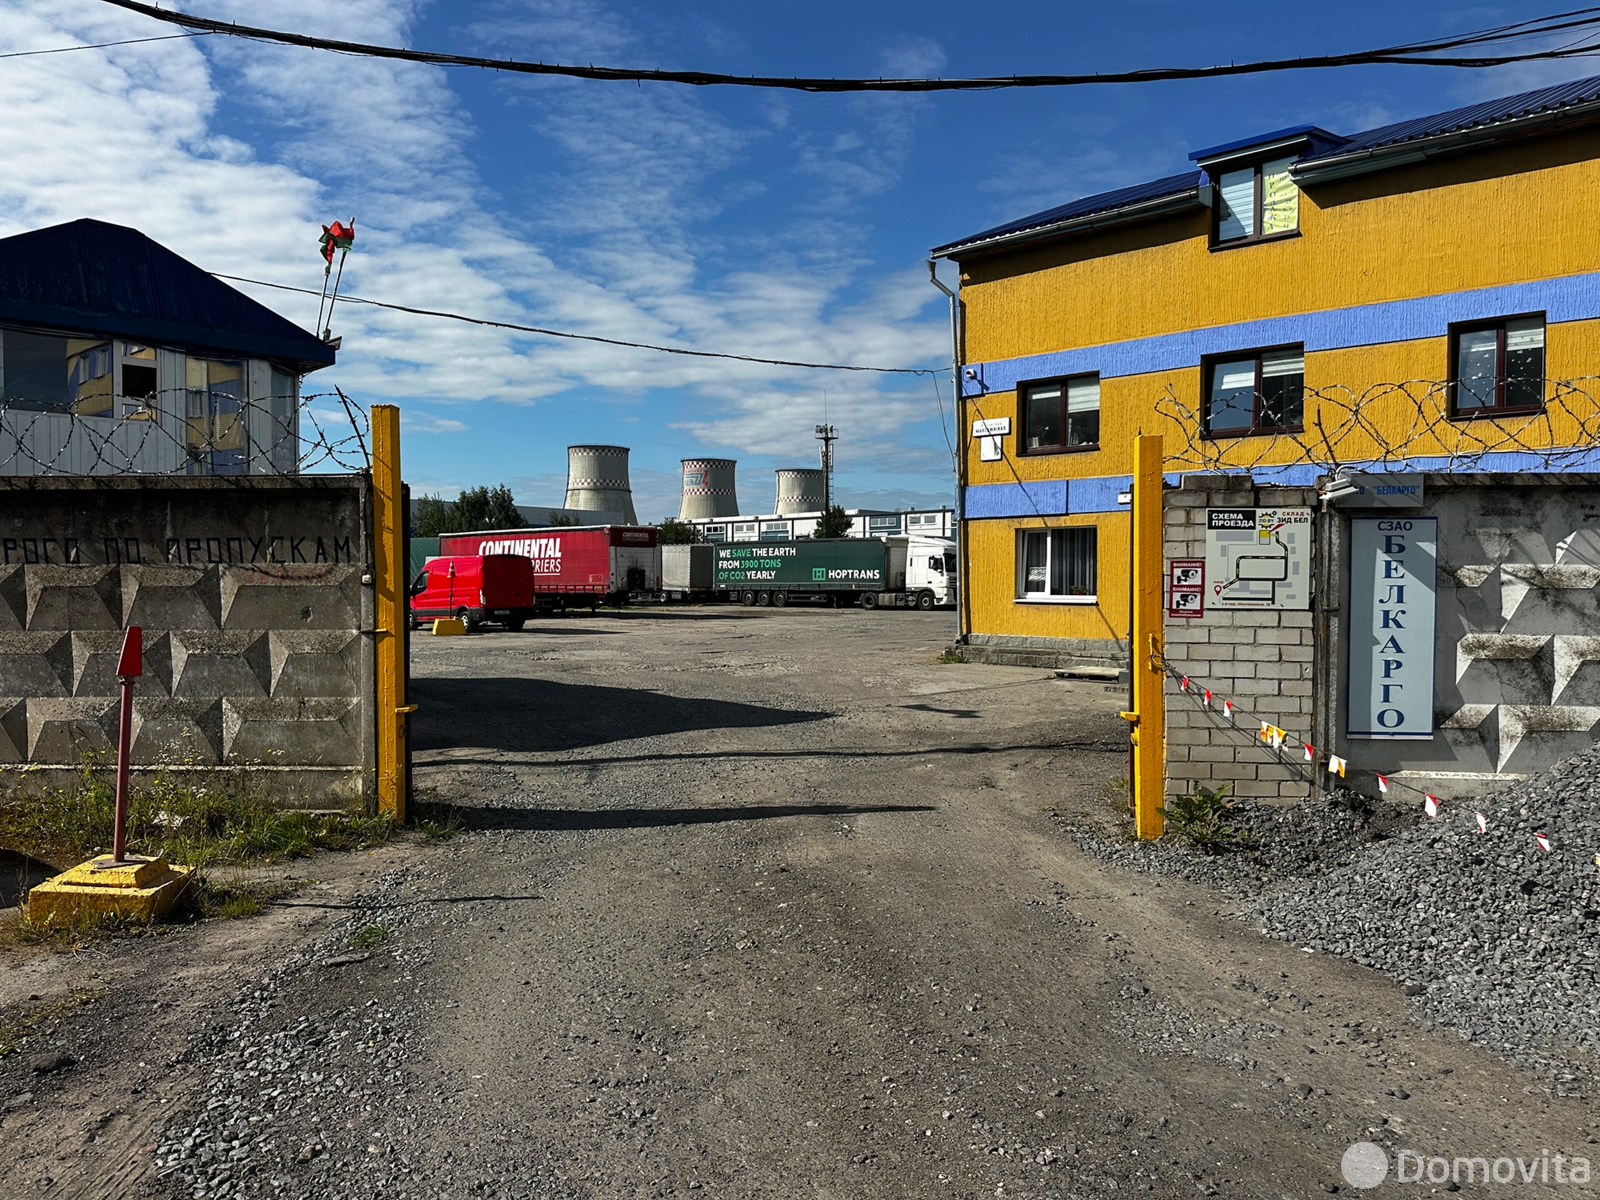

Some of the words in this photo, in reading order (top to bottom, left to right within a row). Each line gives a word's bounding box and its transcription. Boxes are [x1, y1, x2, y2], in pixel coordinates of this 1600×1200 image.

[1377, 520, 1413, 531] СЗАО
[104, 537, 142, 564] ПО
[165, 535, 351, 564] ПРОПУСКАМ
[479, 538, 561, 558] CONTINENTAL
[719, 549, 731, 558] WE
[732, 548, 751, 557] SAVE
[752, 548, 768, 557] THE
[769, 547, 796, 556] EARTH
[718, 560, 740, 569] FROM
[740, 560, 759, 568] 3900
[759, 559, 782, 568] TONS
[718, 572, 729, 580] OF
[729, 571, 745, 580] CO2
[746, 571, 776, 579] YEARLY
[828, 569, 880, 579] HOPTRANS
[1377, 534, 1407, 728] БЕЛКАРГО
